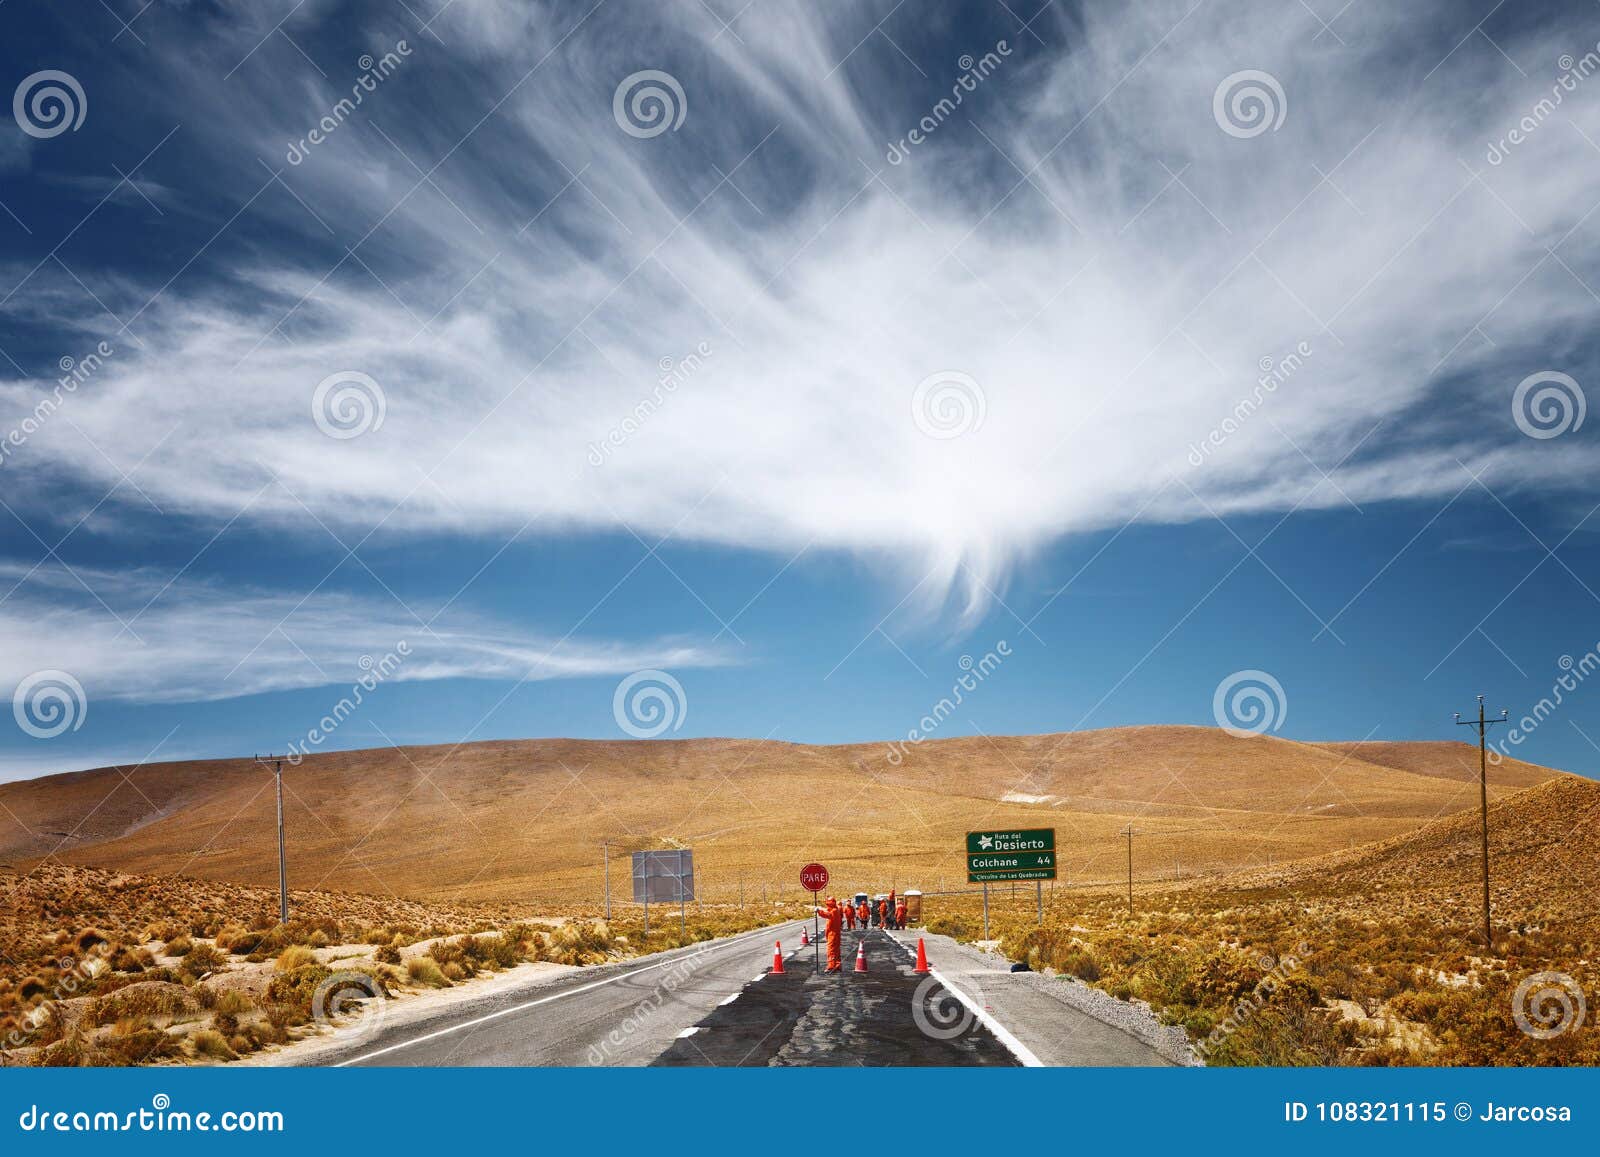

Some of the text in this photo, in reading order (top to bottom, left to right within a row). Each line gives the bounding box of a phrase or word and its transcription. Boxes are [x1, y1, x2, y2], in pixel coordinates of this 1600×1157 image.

[994, 840, 1045, 850] Desierto
[972, 856, 1050, 867] Colchane 44
[803, 873, 825, 882] PARE
